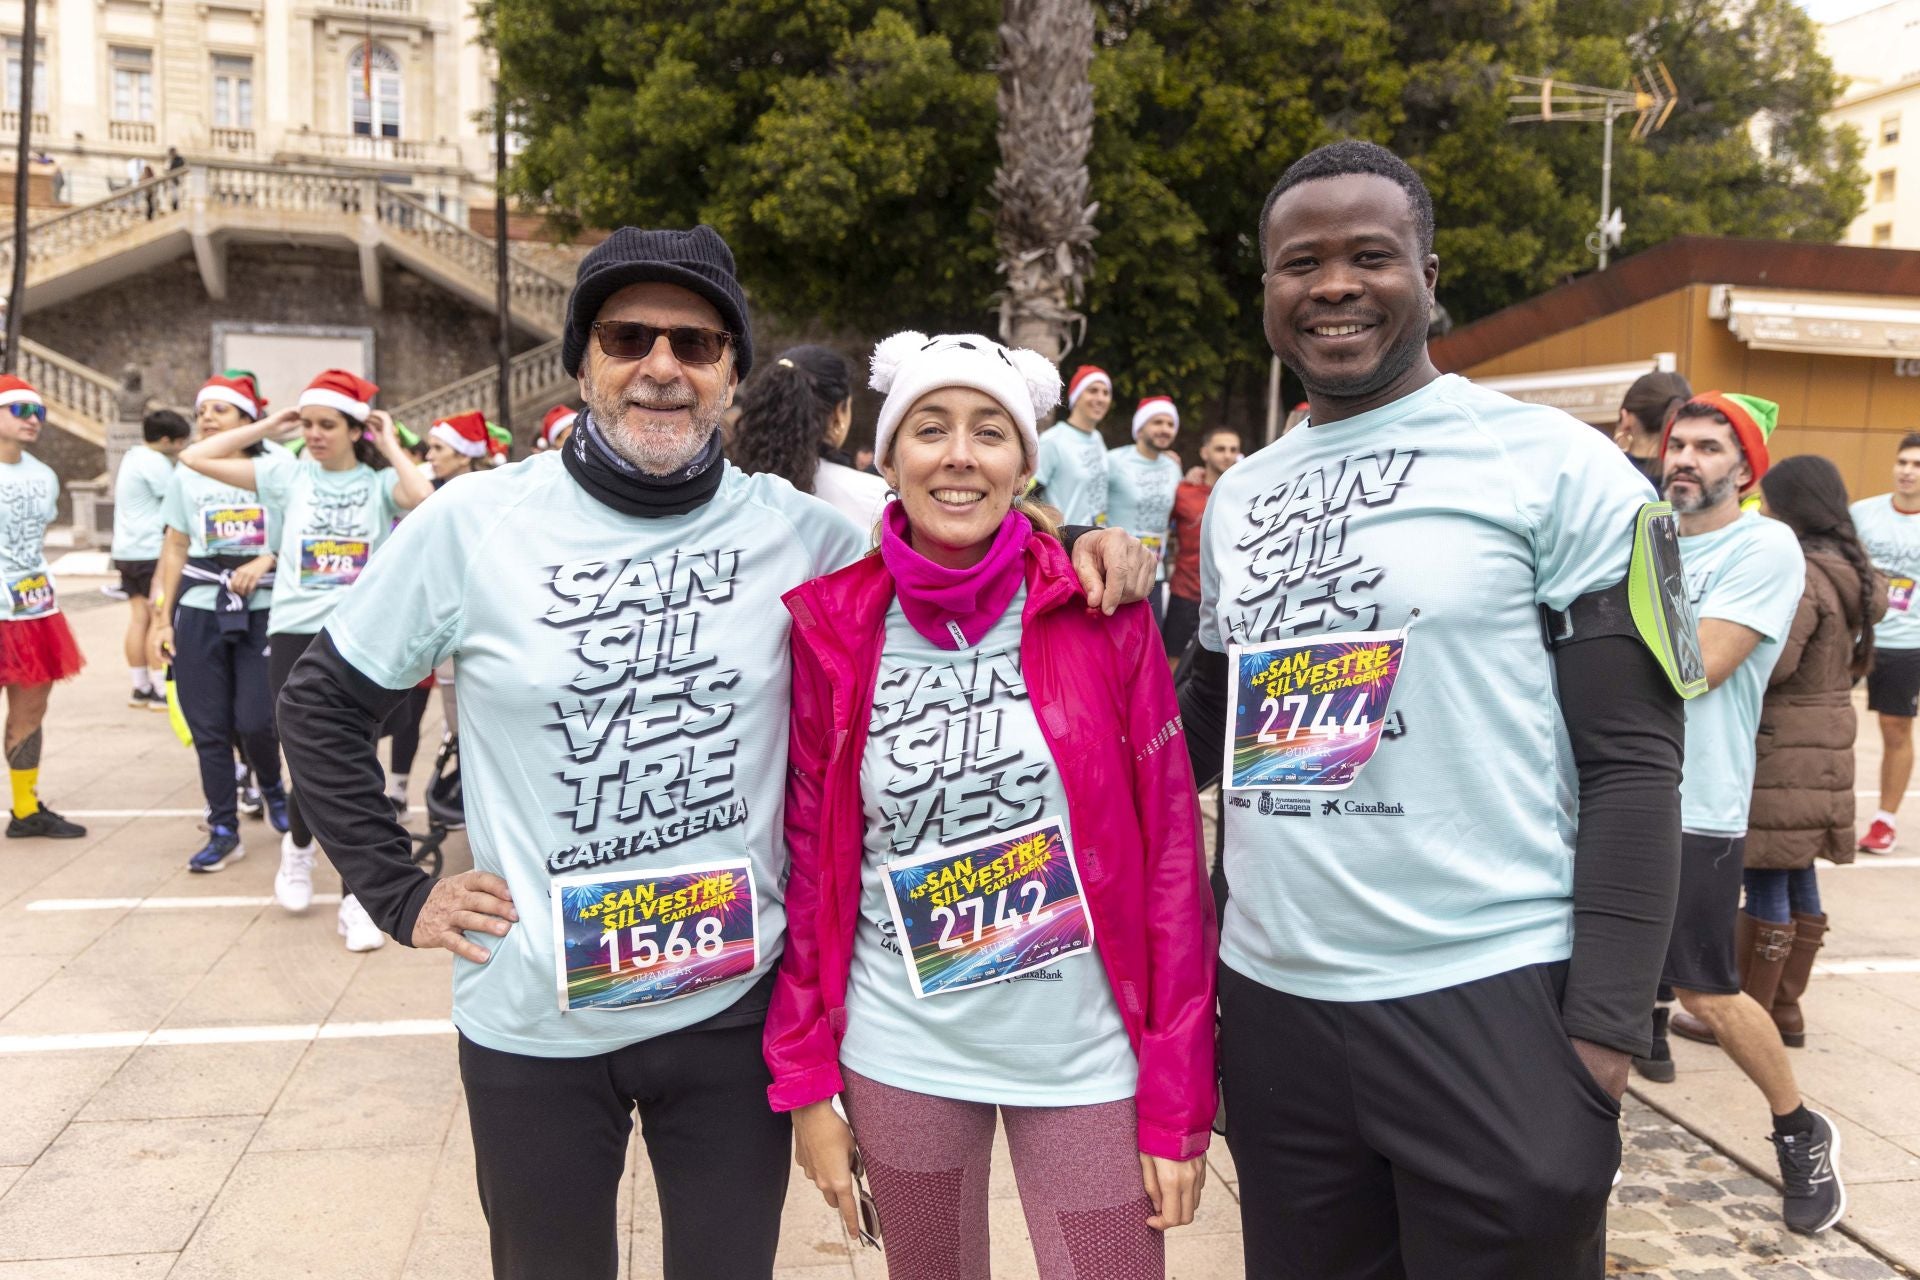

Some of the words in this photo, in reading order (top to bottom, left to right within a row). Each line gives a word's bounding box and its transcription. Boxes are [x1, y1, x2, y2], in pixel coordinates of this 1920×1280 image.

[1234, 448, 1420, 551] SAN
[316, 554, 354, 574] 978
[541, 549, 744, 628] SAN
[1234, 514, 1363, 607] SIL
[1226, 567, 1385, 642] VES
[565, 610, 718, 695] SIL
[1266, 644, 1391, 700] SILVESTRE
[1267, 650, 1311, 681] SAN
[1312, 667, 1389, 696] CARTAGENA
[544, 668, 742, 764] VES
[869, 649, 1030, 736] SAN
[1257, 692, 1370, 743] 2744
[884, 707, 1024, 798] SIL
[552, 739, 740, 833] TRE
[879, 762, 1050, 857] VES
[1275, 802, 1310, 812] Cartagena
[1344, 800, 1404, 813] CaixaBank
[546, 797, 748, 875] CARTAGENA
[602, 882, 656, 913] SAN
[925, 856, 974, 889] SAN
[929, 833, 1047, 909] SILVESTRE
[984, 851, 1053, 895] CARTAGENA
[602, 872, 736, 934] SILVESTRE
[661, 892, 736, 925] CARTAGENA
[930, 880, 1053, 950] 2742
[600, 916, 724, 973] 1568
[880, 938, 891, 950] LA
